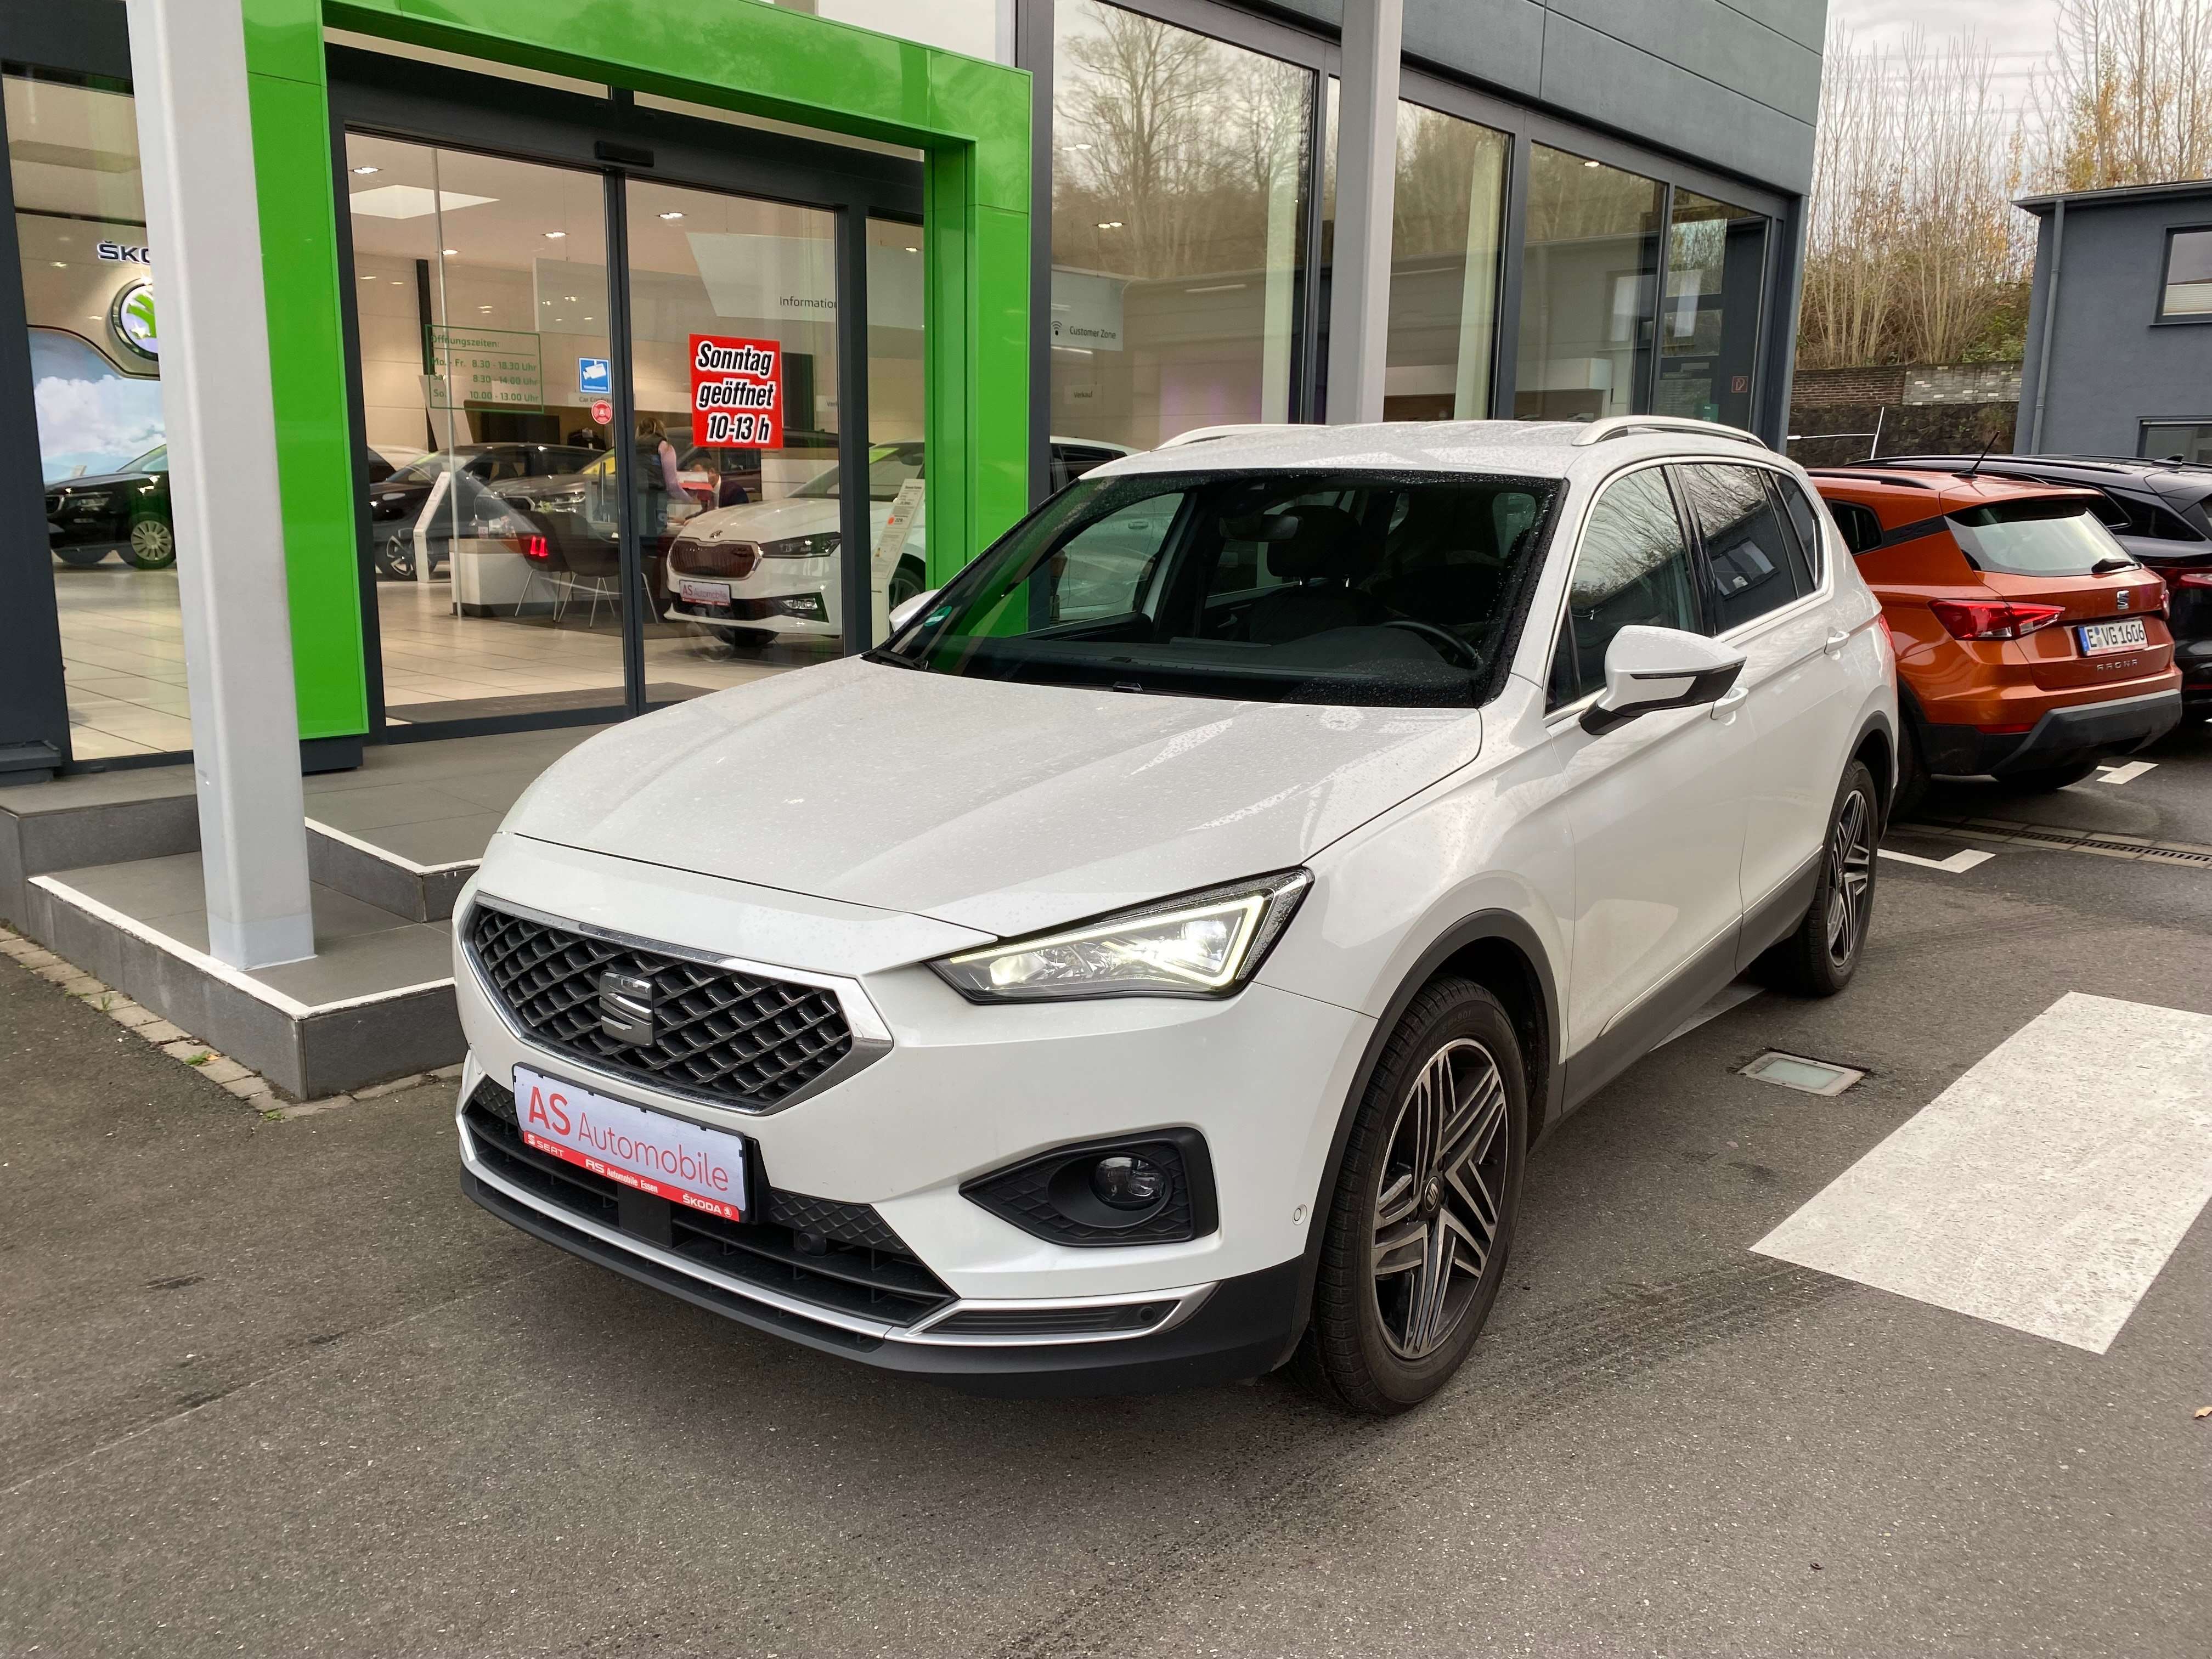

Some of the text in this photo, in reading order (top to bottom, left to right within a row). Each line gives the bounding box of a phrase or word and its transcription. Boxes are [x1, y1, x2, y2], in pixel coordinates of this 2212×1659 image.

[431, 334, 500, 347] Öffnungszeiten:
[1070, 326, 1116, 339] Customer Zone
[455, 358, 466, 367] Fr.
[472, 359, 490, 368] 8.30
[498, 361, 520, 370] 18.30
[522, 362, 537, 371] Uhr
[697, 342, 772, 376] Sonntag
[473, 374, 491, 383] 8.30
[499, 376, 521, 385] 14.00
[523, 377, 540, 386] Uhr
[470, 391, 492, 399] 10.00
[500, 393, 521, 401] 13.00
[524, 393, 539, 402] Uhr
[698, 380, 774, 408] geöffnet
[708, 415, 770, 441] 10-13 h
[682, 584, 727, 599] AS Automobile
[2086, 623, 2145, 648] E VG 1606
[2096, 659, 2138, 672] ARONA
[527, 1086, 729, 1192] AS Automobile
[537, 1140, 564, 1157] SEAT
[607, 1167, 639, 1187] Automobile
[640, 1179, 658, 1194] Essen
[682, 1193, 722, 1215] ŠKODA
